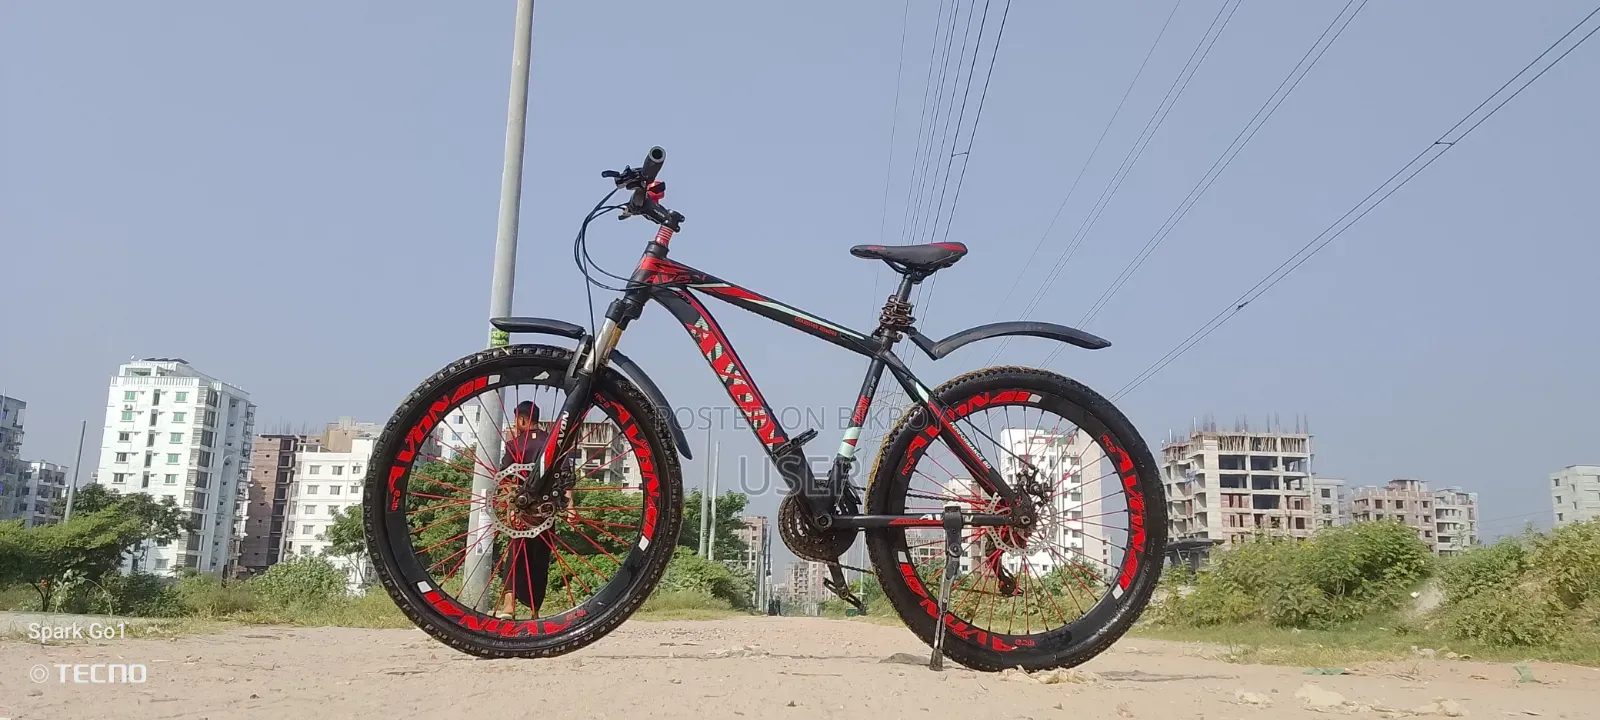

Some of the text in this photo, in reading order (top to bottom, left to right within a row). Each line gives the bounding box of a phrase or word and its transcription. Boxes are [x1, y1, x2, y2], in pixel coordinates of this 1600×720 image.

[685, 322, 785, 447] AVON
[557, 410, 570, 449] AVON
[949, 421, 984, 461] PERFORMANCE
[919, 513, 974, 523] AVN
